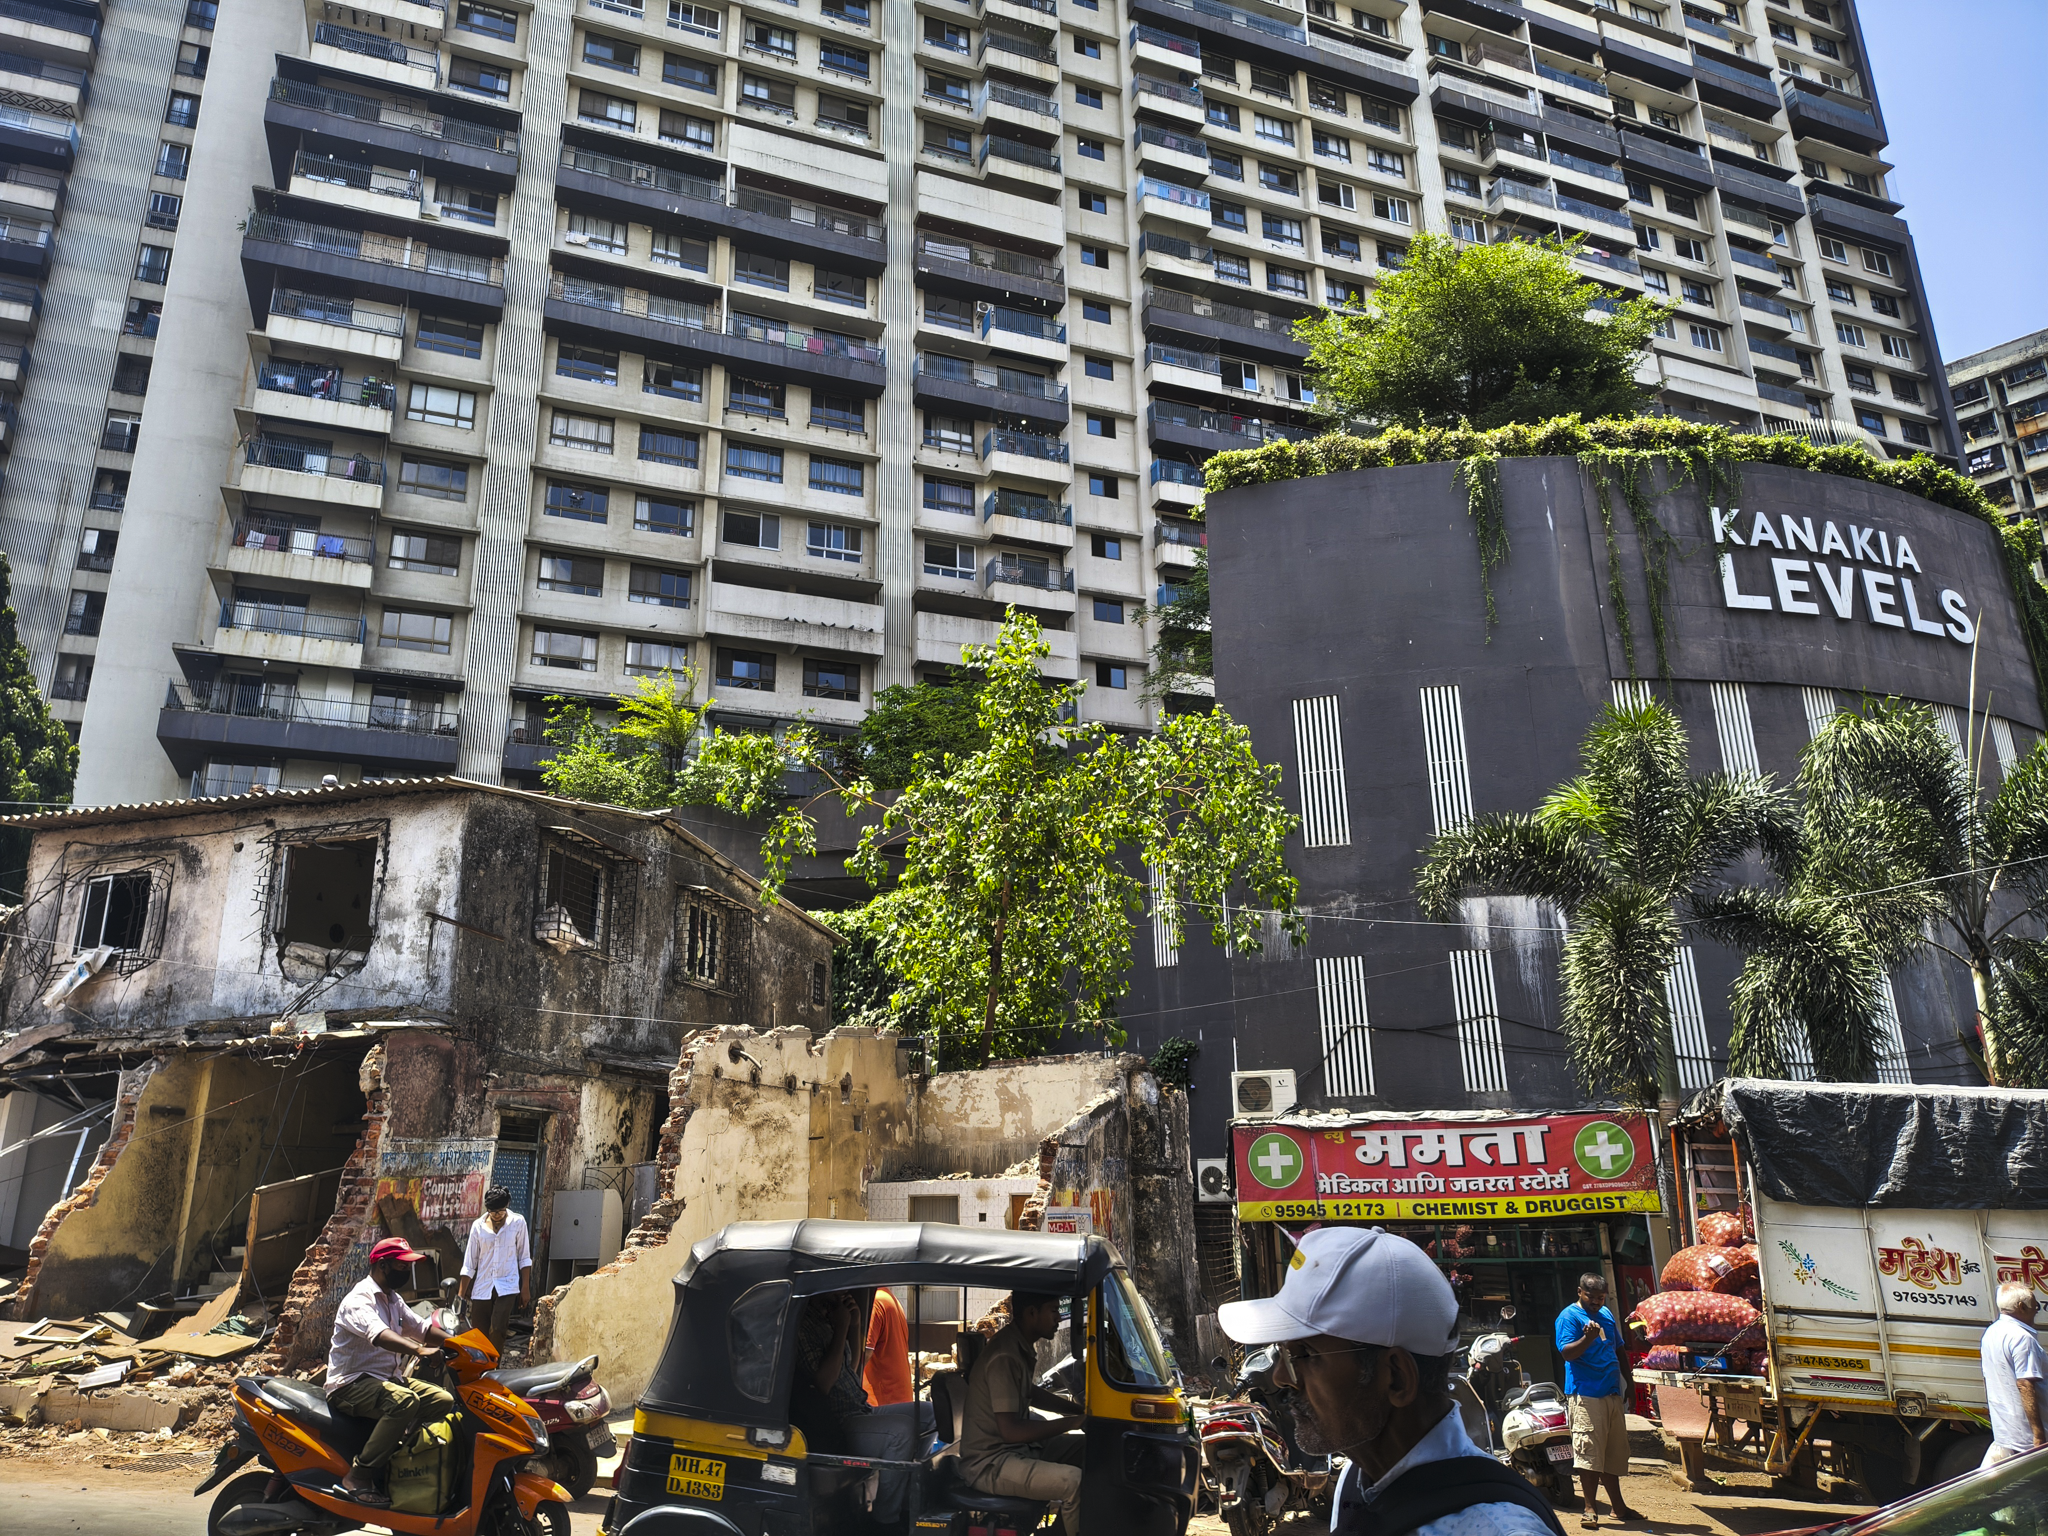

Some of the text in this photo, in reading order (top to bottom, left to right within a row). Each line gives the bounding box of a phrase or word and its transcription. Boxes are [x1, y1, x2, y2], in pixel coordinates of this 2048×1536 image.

[1709, 506, 1922, 574] KANAKIA
[1718, 552, 1975, 644] LEVELS
[1350, 1125, 1549, 1168] ममता
[1317, 1167, 1571, 1195] मेडिकल आणि जनरल स्टोर्स
[1275, 1195, 1627, 1219] 95945 12173 CHEMIST & DRUGGIST
[1878, 1236, 1962, 1290] महेश
[1892, 1290, 1977, 1307] 9769357149
[1851, 1383, 1886, 1392] LONG
[673, 1456, 723, 1477] MH.47
[668, 1477, 721, 1499] D.1383
